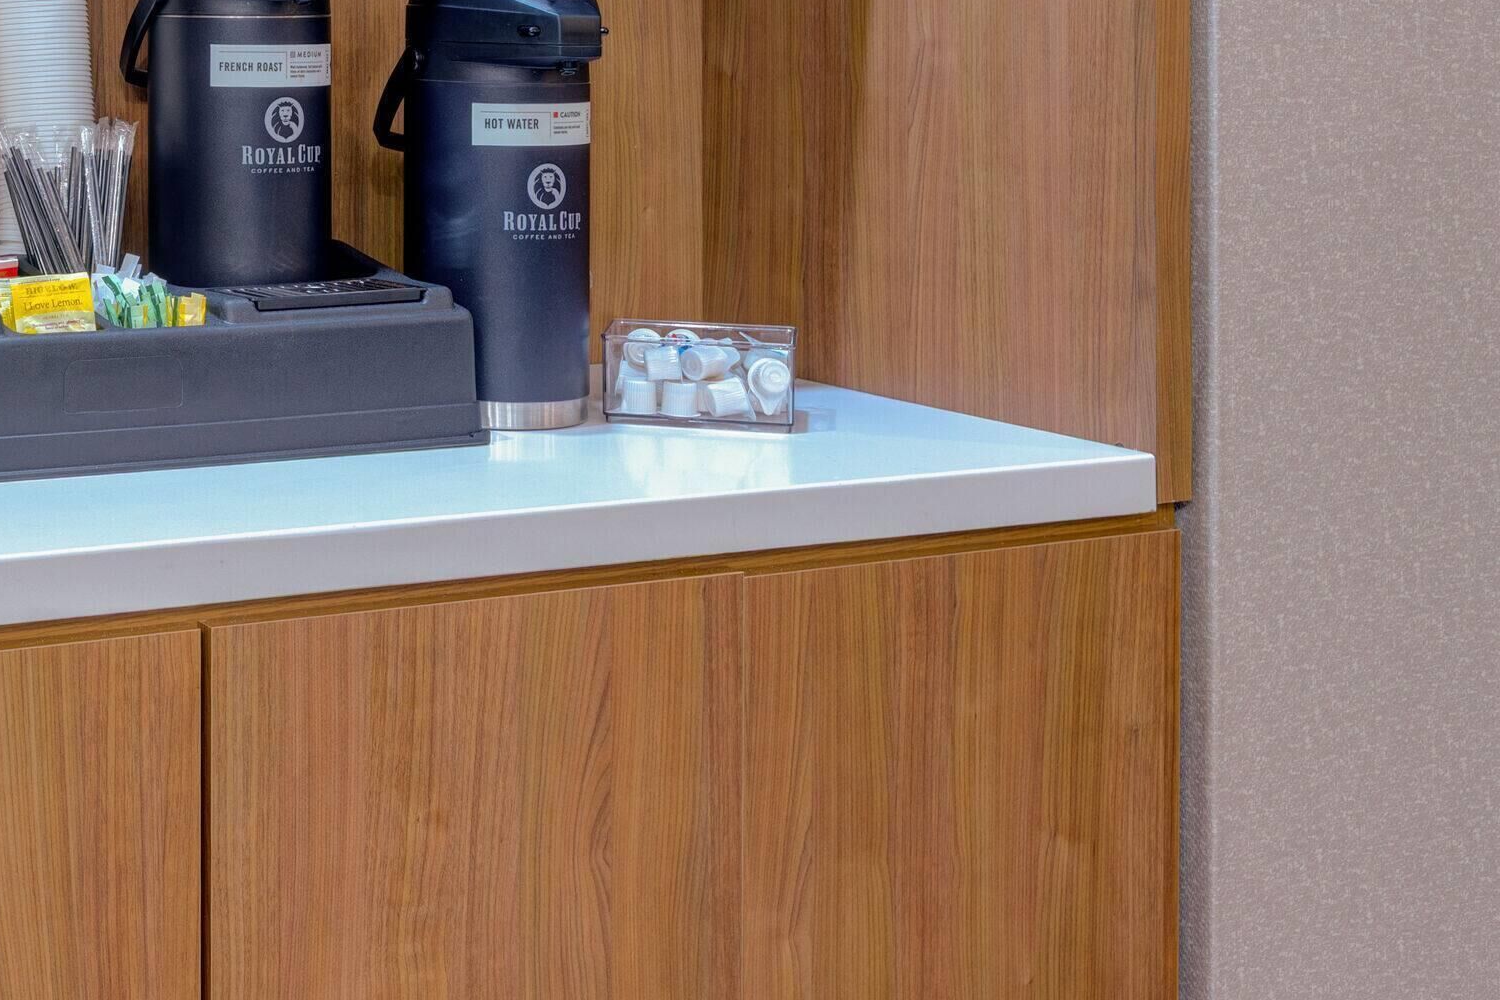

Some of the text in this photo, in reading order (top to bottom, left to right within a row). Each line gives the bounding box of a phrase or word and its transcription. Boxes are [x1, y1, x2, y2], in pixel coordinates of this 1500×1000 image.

[219, 61, 283, 72] FRENCH ROAST
[484, 118, 539, 130] HOT WATER
[241, 144, 321, 165] ROYAL CUP
[503, 210, 581, 231] ROYAL CUP
